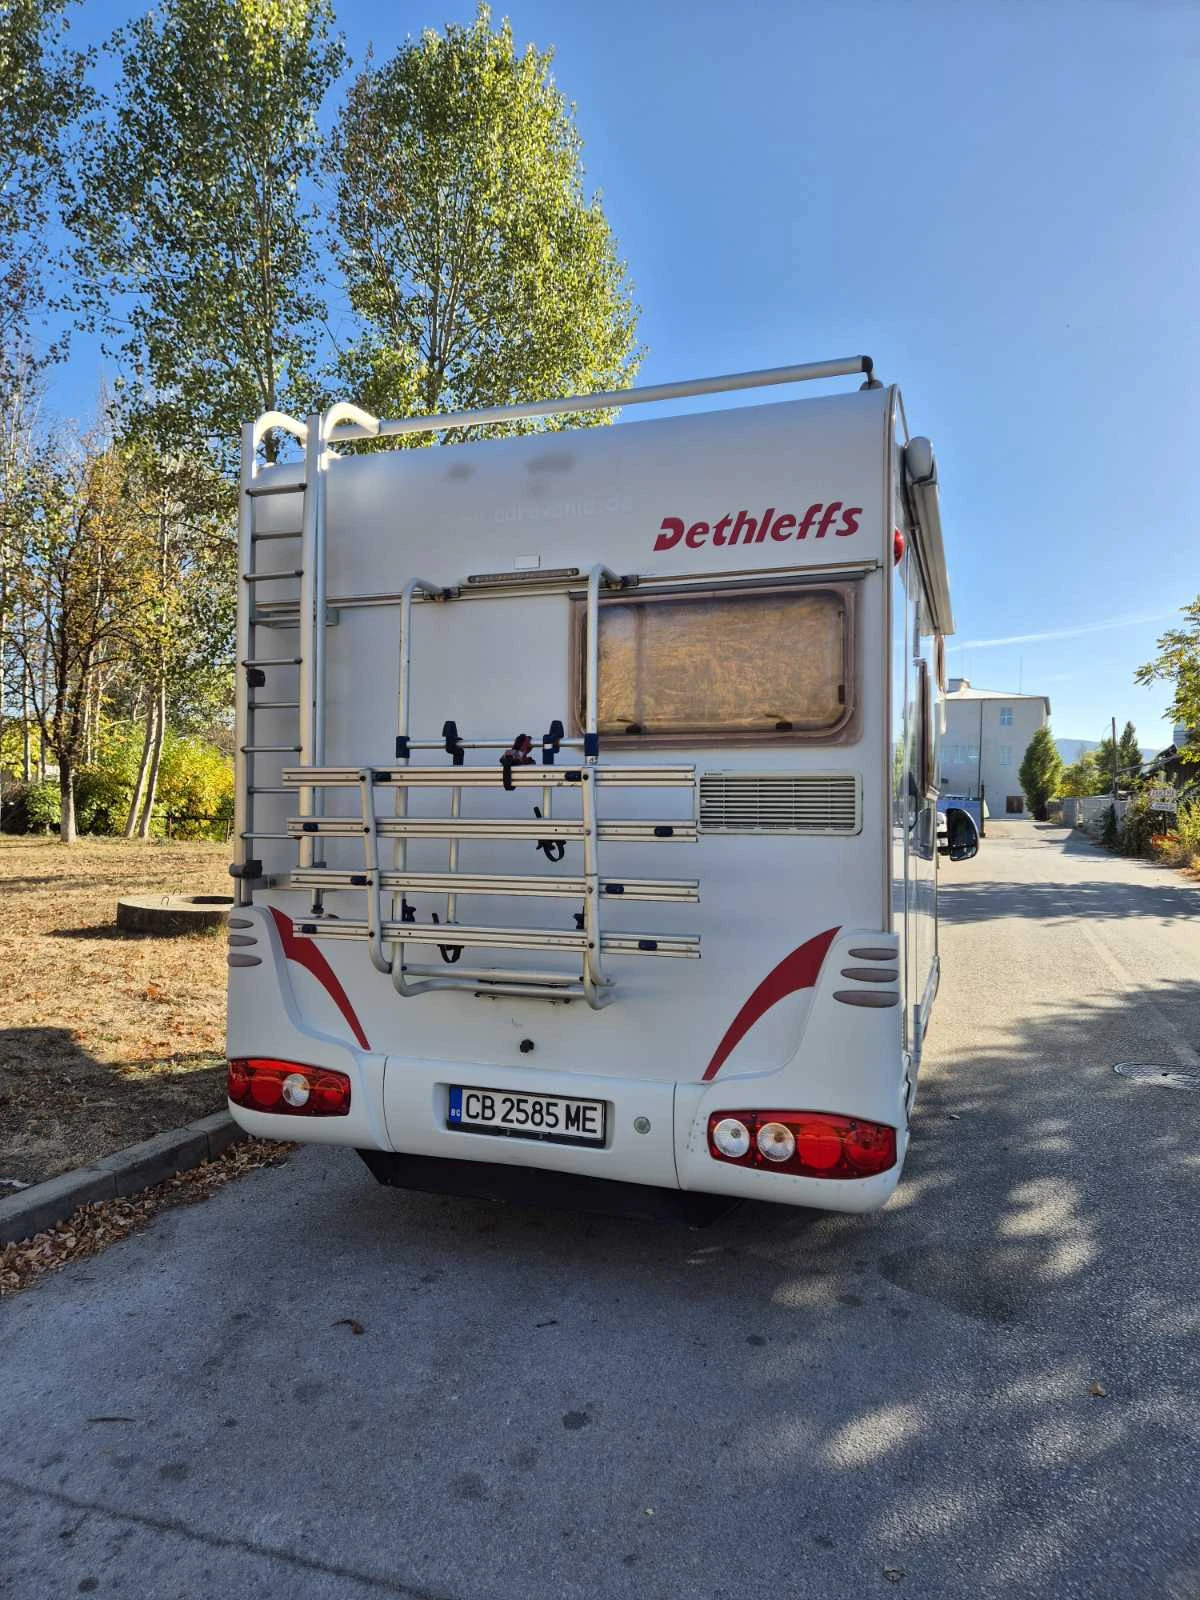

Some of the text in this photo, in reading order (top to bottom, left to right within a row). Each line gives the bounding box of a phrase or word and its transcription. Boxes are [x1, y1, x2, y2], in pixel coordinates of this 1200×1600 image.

[653, 502, 863, 551] Dethleffs
[465, 1094, 597, 1133] CB 2585 ME
